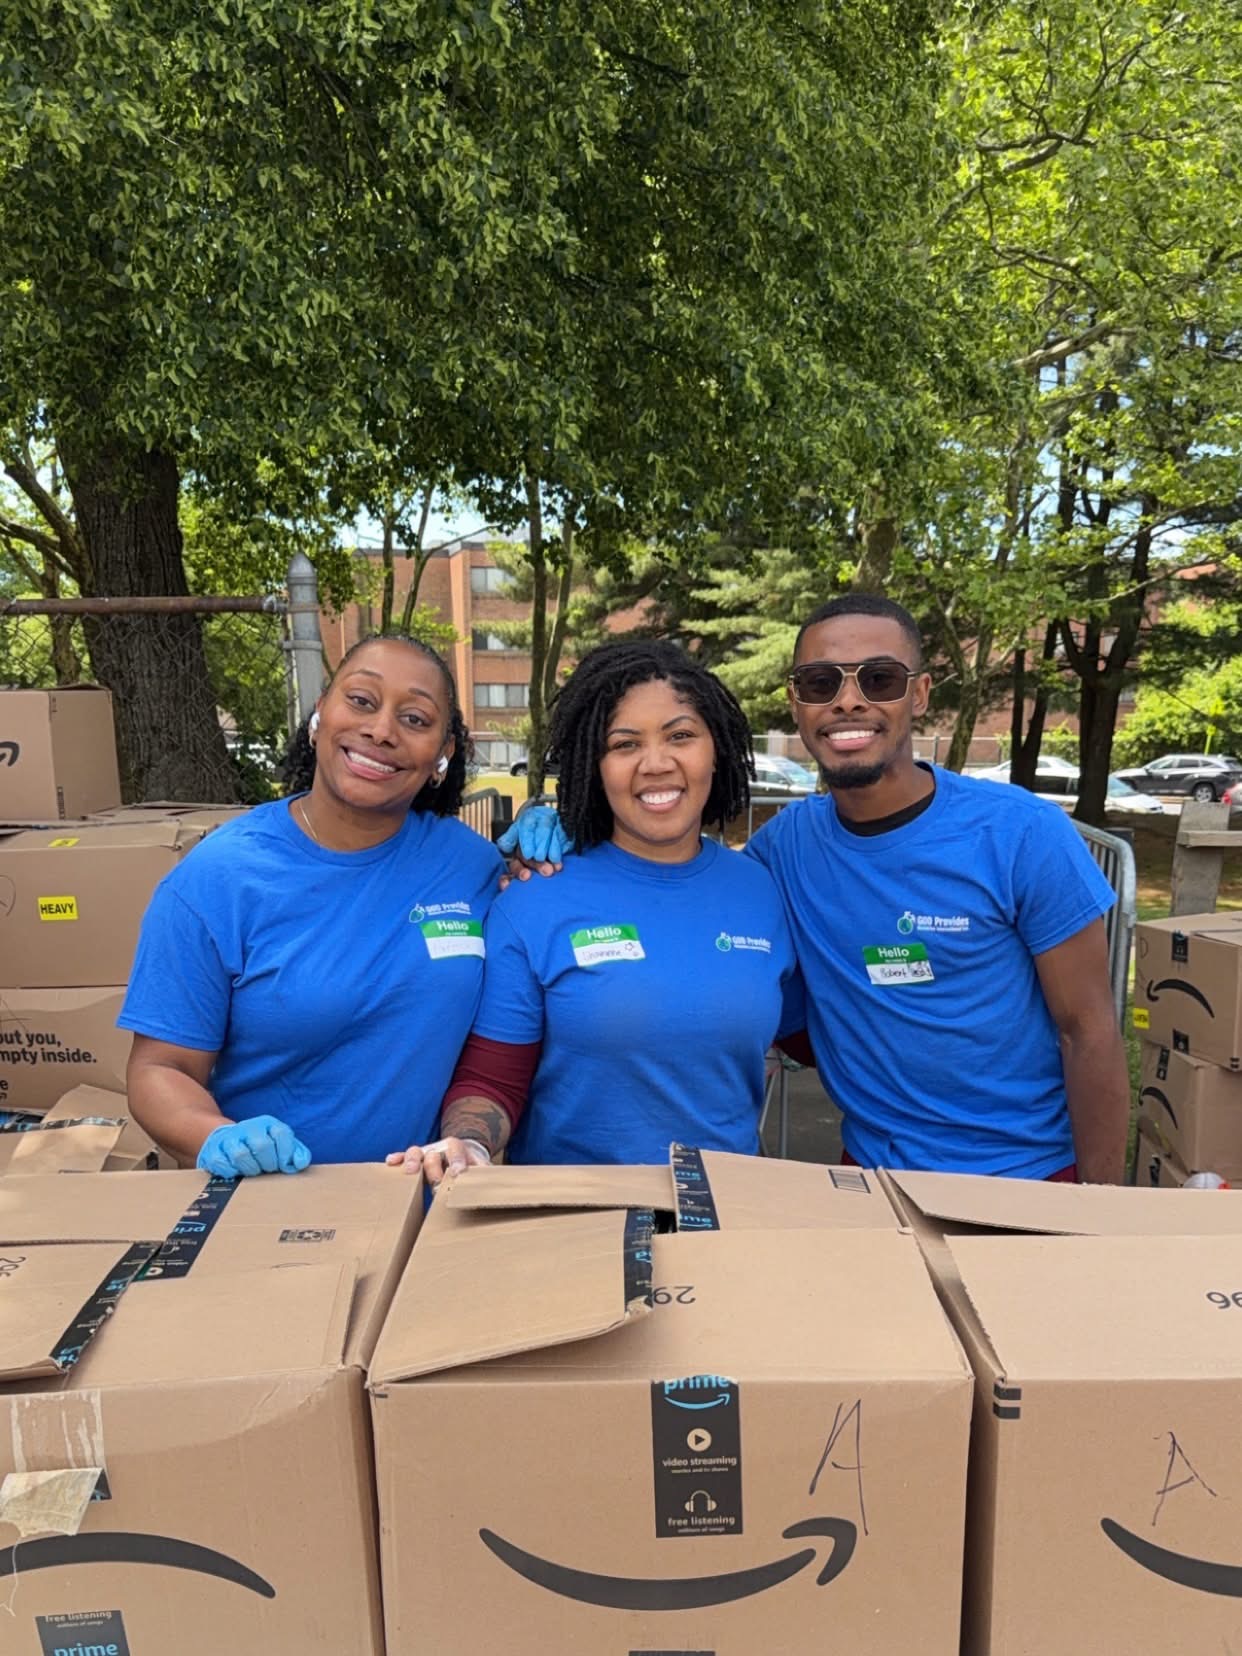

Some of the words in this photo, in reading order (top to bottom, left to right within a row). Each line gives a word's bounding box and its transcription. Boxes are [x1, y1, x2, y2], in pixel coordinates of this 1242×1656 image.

[40, 903, 75, 915] HEAVY
[436, 920, 470, 931] Hello
[586, 926, 622, 939] Hello
[877, 947, 910, 958] Hello
[25, 1032, 61, 1048] you,
[41, 1048, 97, 1063] inside.
[653, 1286, 696, 1305] 29
[662, 1457, 688, 1467] video
[690, 1455, 737, 1466] streaming
[808, 1399, 869, 1537] A
[1151, 1431, 1218, 1527] A
[667, 1517, 688, 1527] free
[691, 1515, 735, 1526] listening
[68, 1611, 112, 1621] listening
[54, 1643, 119, 1656] prime
